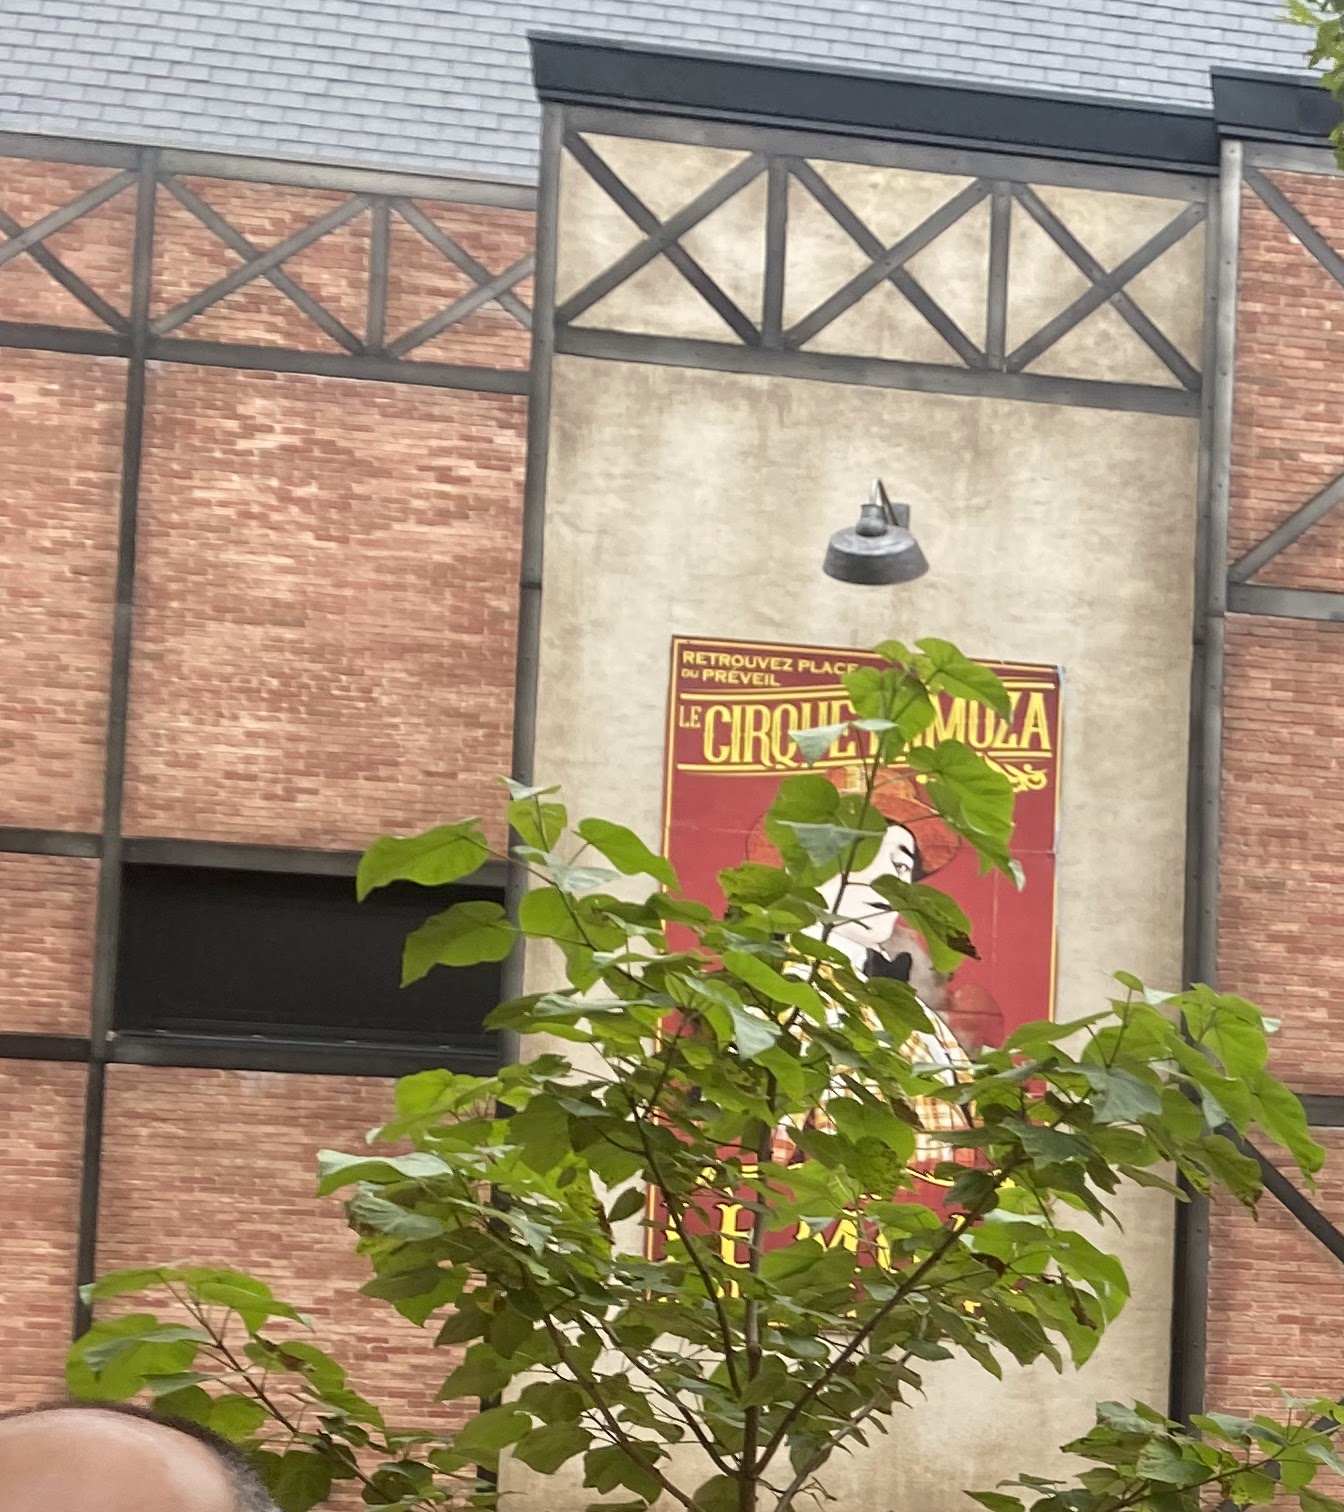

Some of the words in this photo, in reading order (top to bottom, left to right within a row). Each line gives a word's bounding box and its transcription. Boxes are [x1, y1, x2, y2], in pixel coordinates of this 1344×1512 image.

[682, 650, 794, 671] RETROUVEZ
[681, 668, 699, 679] DU
[702, 667, 782, 687] PRÉVEIL
[679, 705, 702, 728] LE
[869, 692, 1051, 756] MUZA
